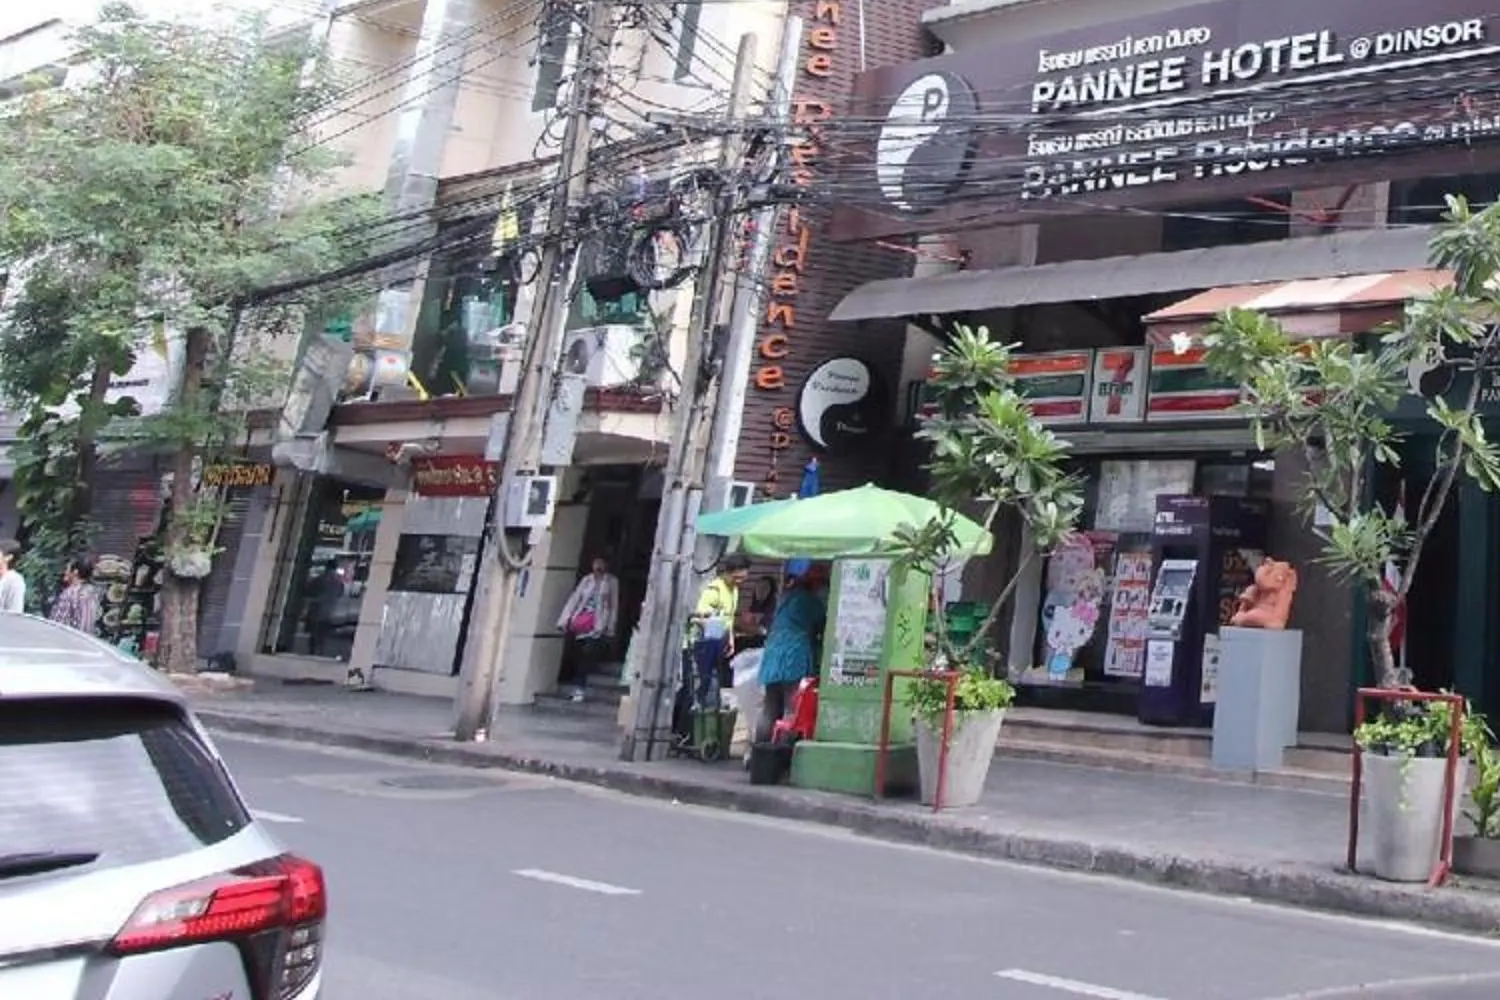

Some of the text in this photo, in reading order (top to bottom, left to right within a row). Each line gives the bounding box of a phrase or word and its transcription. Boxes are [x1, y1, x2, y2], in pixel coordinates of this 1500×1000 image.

[1031, 56, 1187, 113] PANNEE
[1201, 29, 1345, 84] HOTEL
[1374, 18, 1483, 56] DINSOR
[1103, 352, 1135, 415] 7
